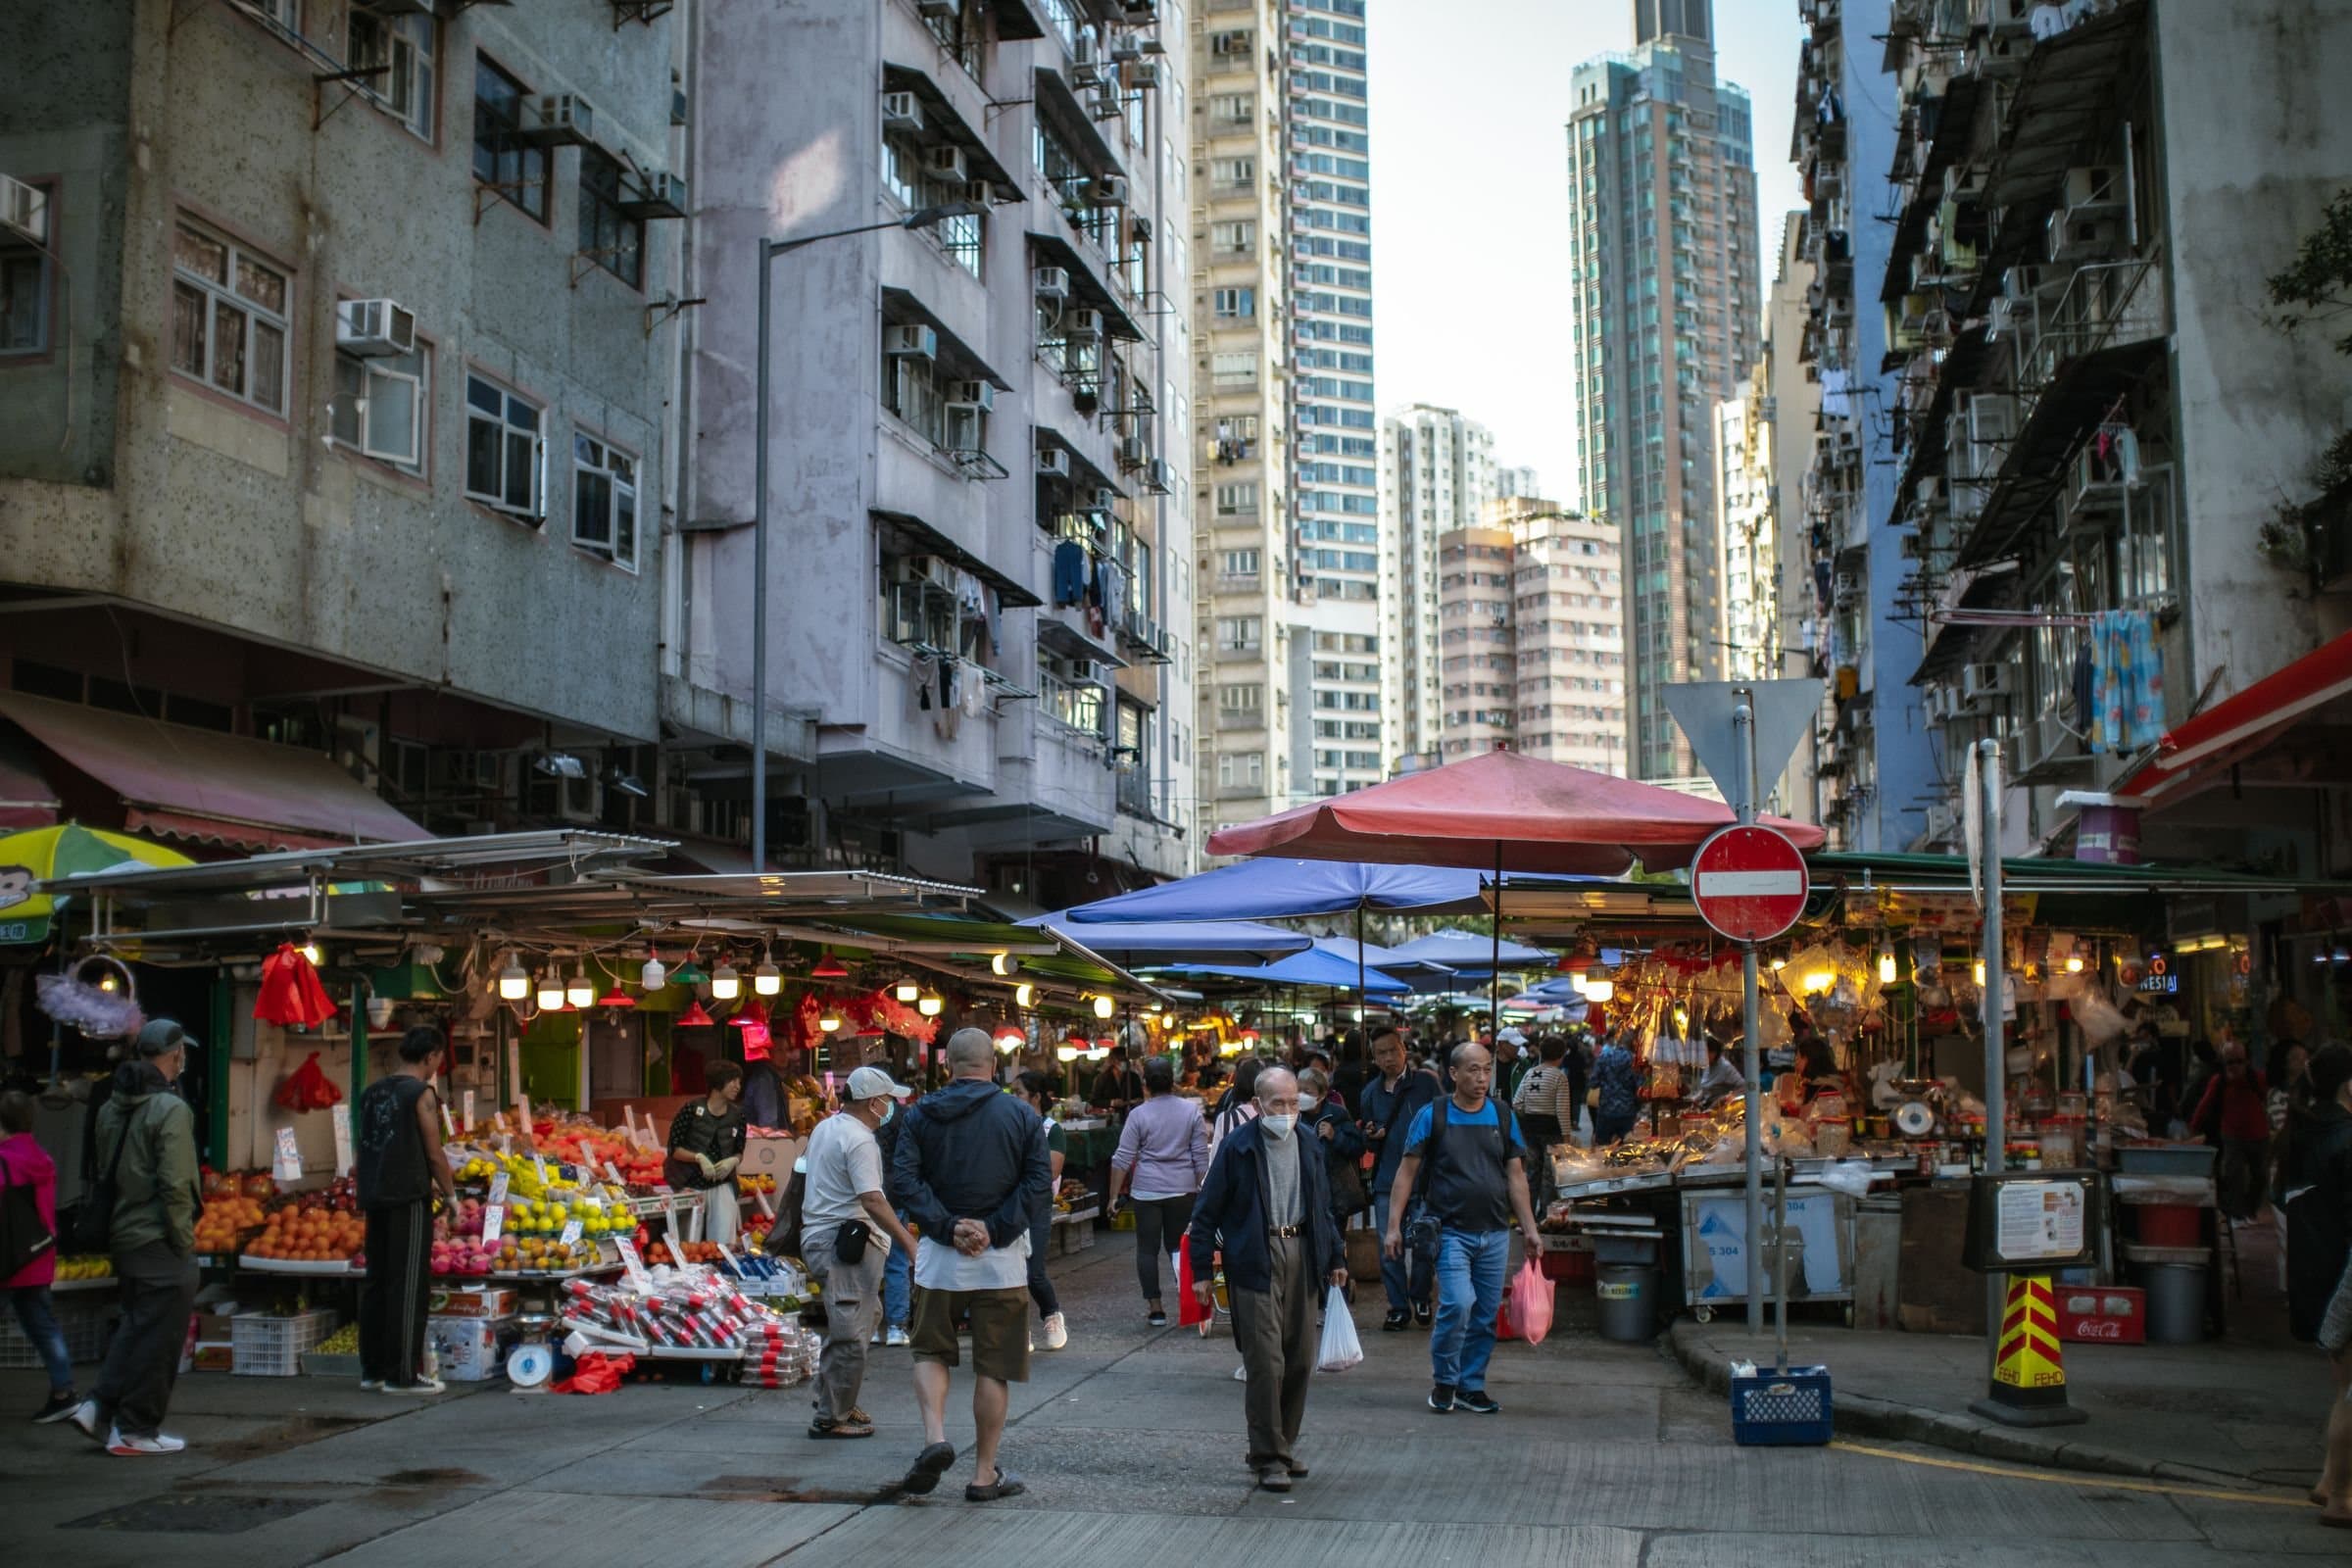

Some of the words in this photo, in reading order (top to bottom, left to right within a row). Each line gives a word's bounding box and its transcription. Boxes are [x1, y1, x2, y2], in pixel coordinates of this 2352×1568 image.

[1787, 1201, 1805, 1211] 304
[1719, 1246, 1739, 1255] 304
[2034, 1371, 2064, 1386] FEHD
